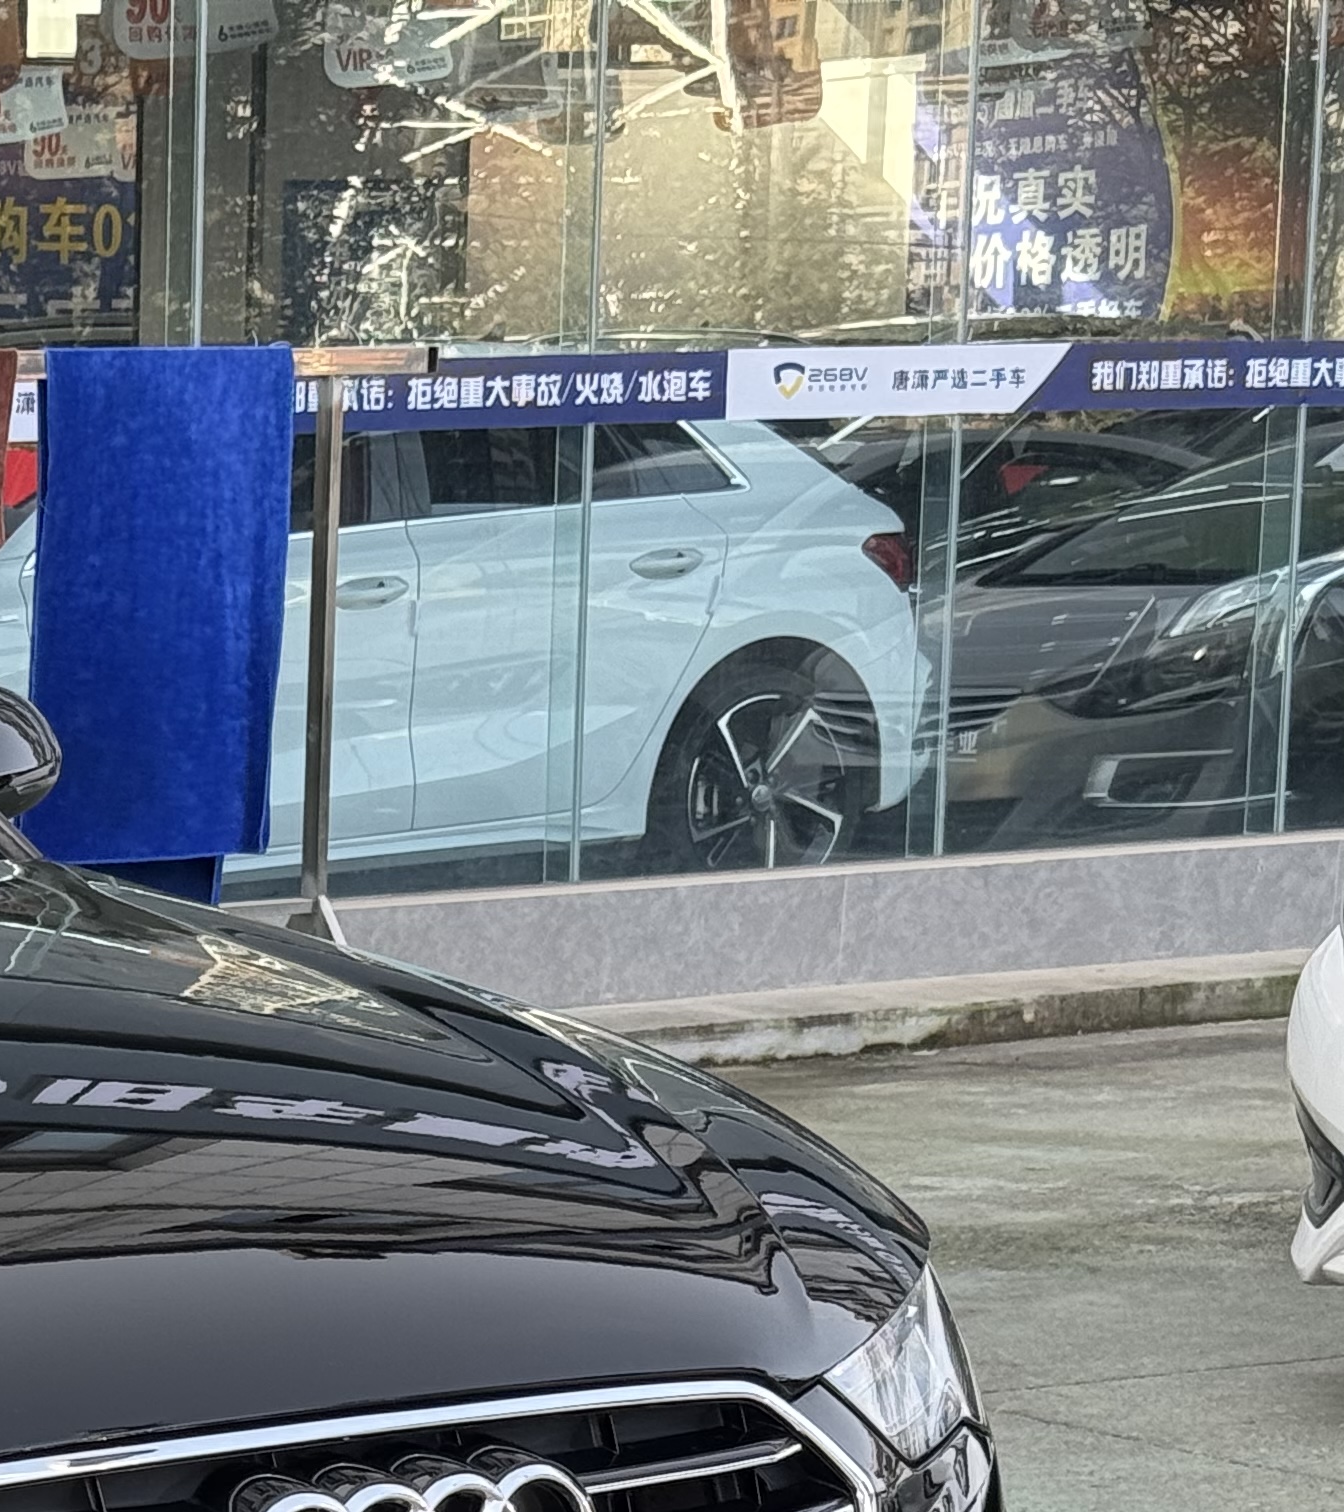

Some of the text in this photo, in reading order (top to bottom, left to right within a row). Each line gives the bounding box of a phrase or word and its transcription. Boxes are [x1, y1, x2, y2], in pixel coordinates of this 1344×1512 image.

[217, 25, 229, 42] 6
[970, 224, 1149, 289] 价格透明
[808, 366, 869, 382] 268V
[891, 366, 1027, 391] 唐潇严选二手车
